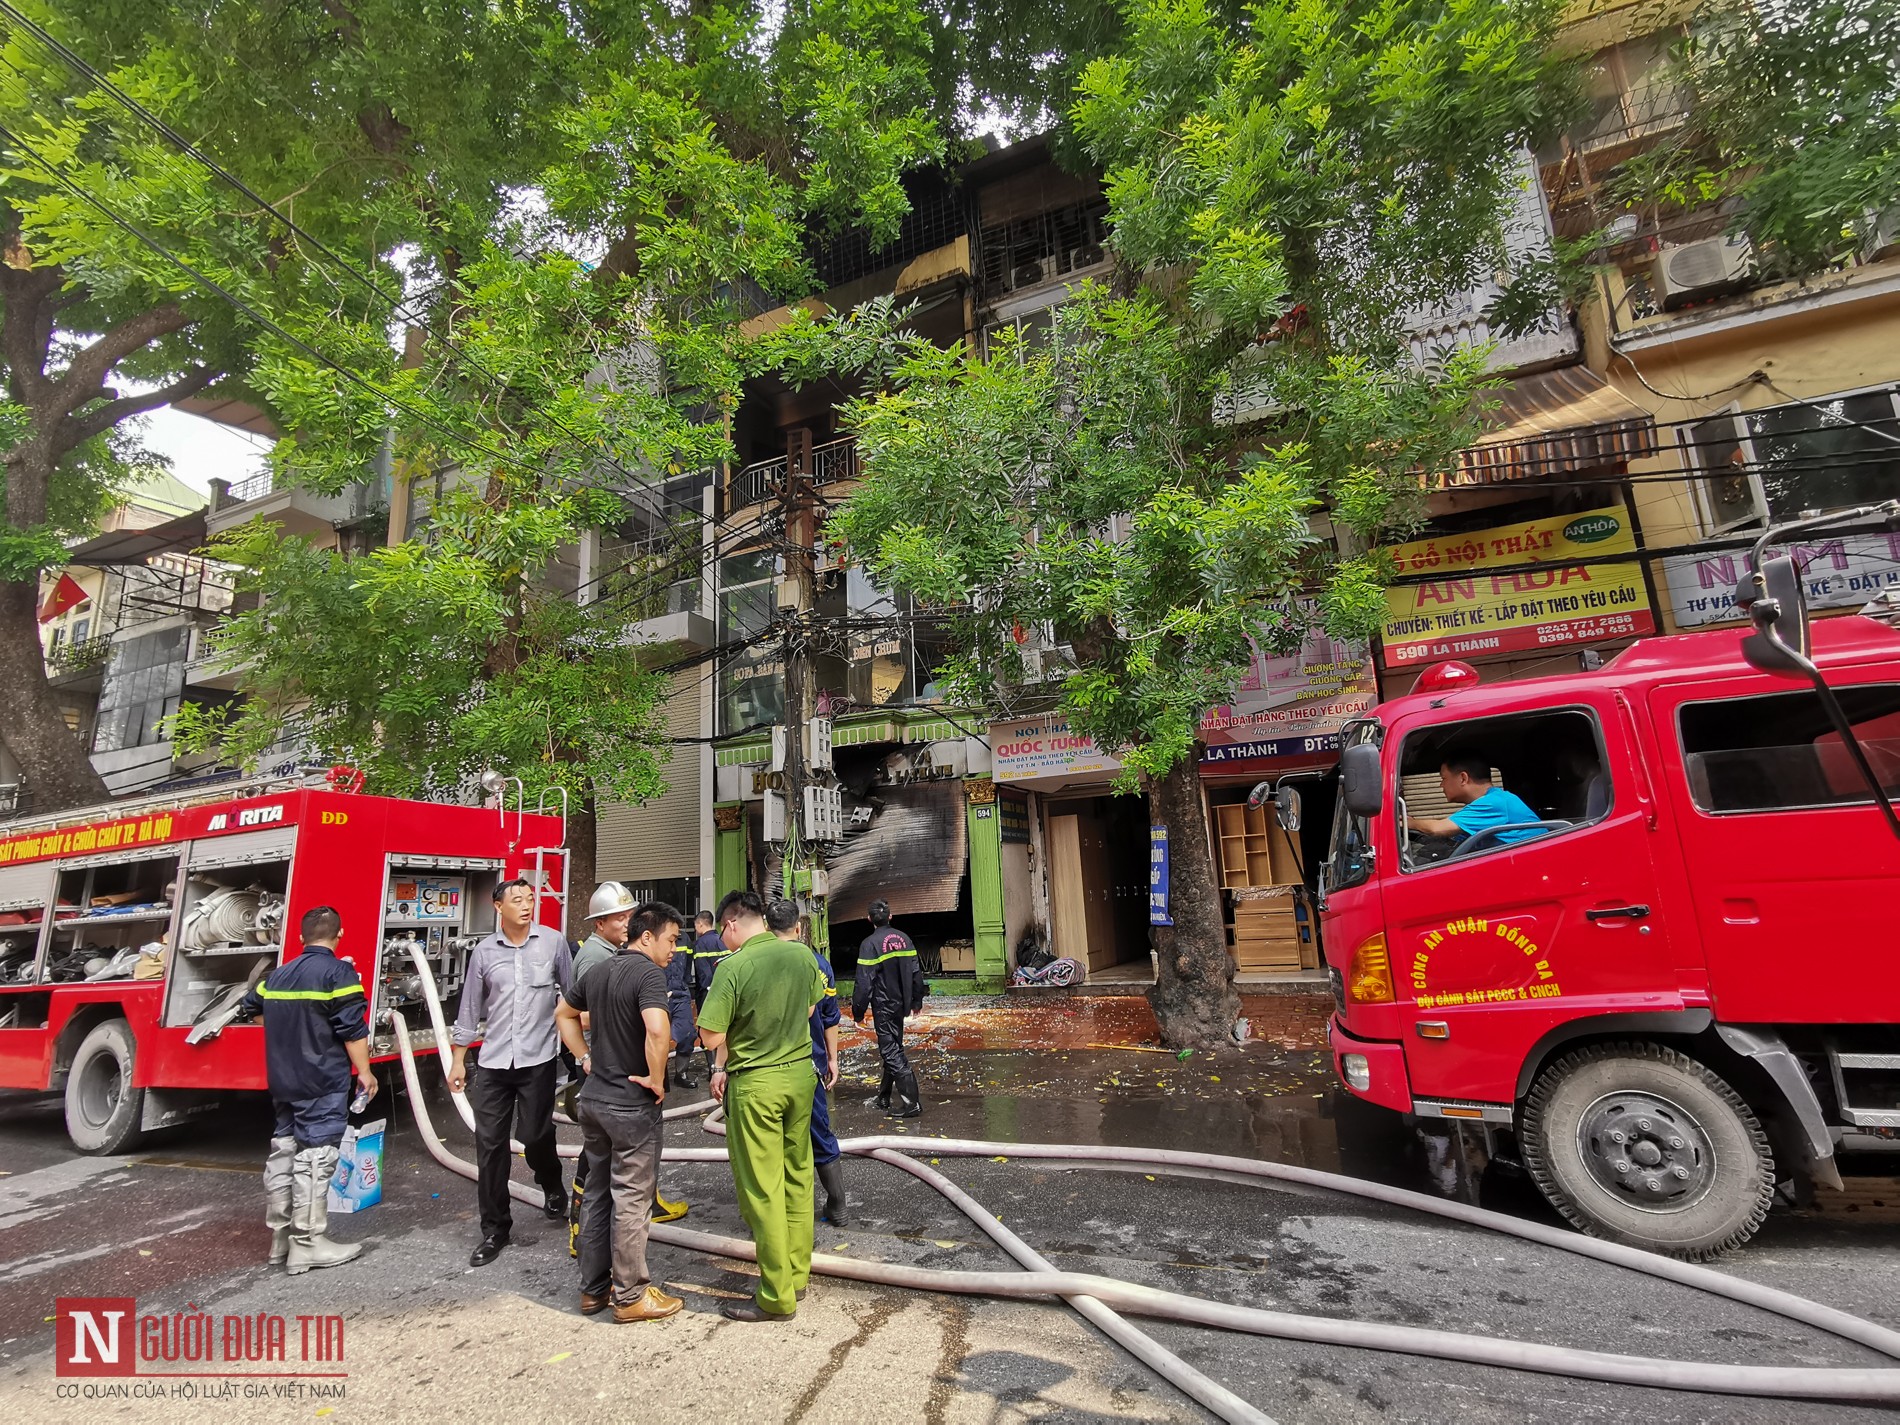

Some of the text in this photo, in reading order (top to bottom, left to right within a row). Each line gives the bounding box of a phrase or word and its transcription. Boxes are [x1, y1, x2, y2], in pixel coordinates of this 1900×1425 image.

[1410, 542, 1441, 570] GỖ
[1446, 540, 1486, 565] NỘI
[1491, 526, 1554, 556] THẤT
[1417, 557, 1592, 607] AN HÒA
[1810, 577, 1832, 596] KẾ
[1849, 574, 1881, 592] ĐẶT
[1387, 616, 1434, 637] CHUYÊN:
[1435, 608, 1467, 630] THIẾT
[1470, 604, 1486, 625] KẾ
[1496, 600, 1519, 622] LẮP
[1521, 598, 1545, 620] ĐẶT
[1547, 595, 1580, 614] THEO
[1581, 590, 1607, 610] YÊU
[1610, 583, 1637, 605] CẦU
[1687, 597, 1708, 612] TƯ
[1571, 620, 1595, 630] 771
[1396, 636, 1500, 660] 590 LA THÀNH
[1317, 688, 1335, 698] HỌC
[1201, 697, 1369, 731] NHẬN ĐẶT HÀNG THEO YÊU CẦU
[1015, 726, 1039, 739] NỘI
[997, 738, 1043, 757] QUỐC
[1207, 749, 1226, 761] LA
[1228, 741, 1278, 759] THÀNH
[1304, 737, 1329, 752] ĐT:
[1000, 771, 1014, 779] 592
[207, 806, 284, 831] MORITA
[13, 836, 41, 860] PHÒNG
[41, 831, 64, 855] CHÁY
[64, 834, 72, 852] &
[73, 826, 97, 852] CHỮA
[98, 822, 124, 848] CHÁY
[138, 817, 153, 842] HÀ
[153, 813, 173, 843] NỘI
[1410, 917, 1554, 989] CÔNG AN QUẬN ĐỐNG ĐA
[1417, 984, 1561, 1009] ĐỘI CẢNH SÁT PCCC & CNCH
